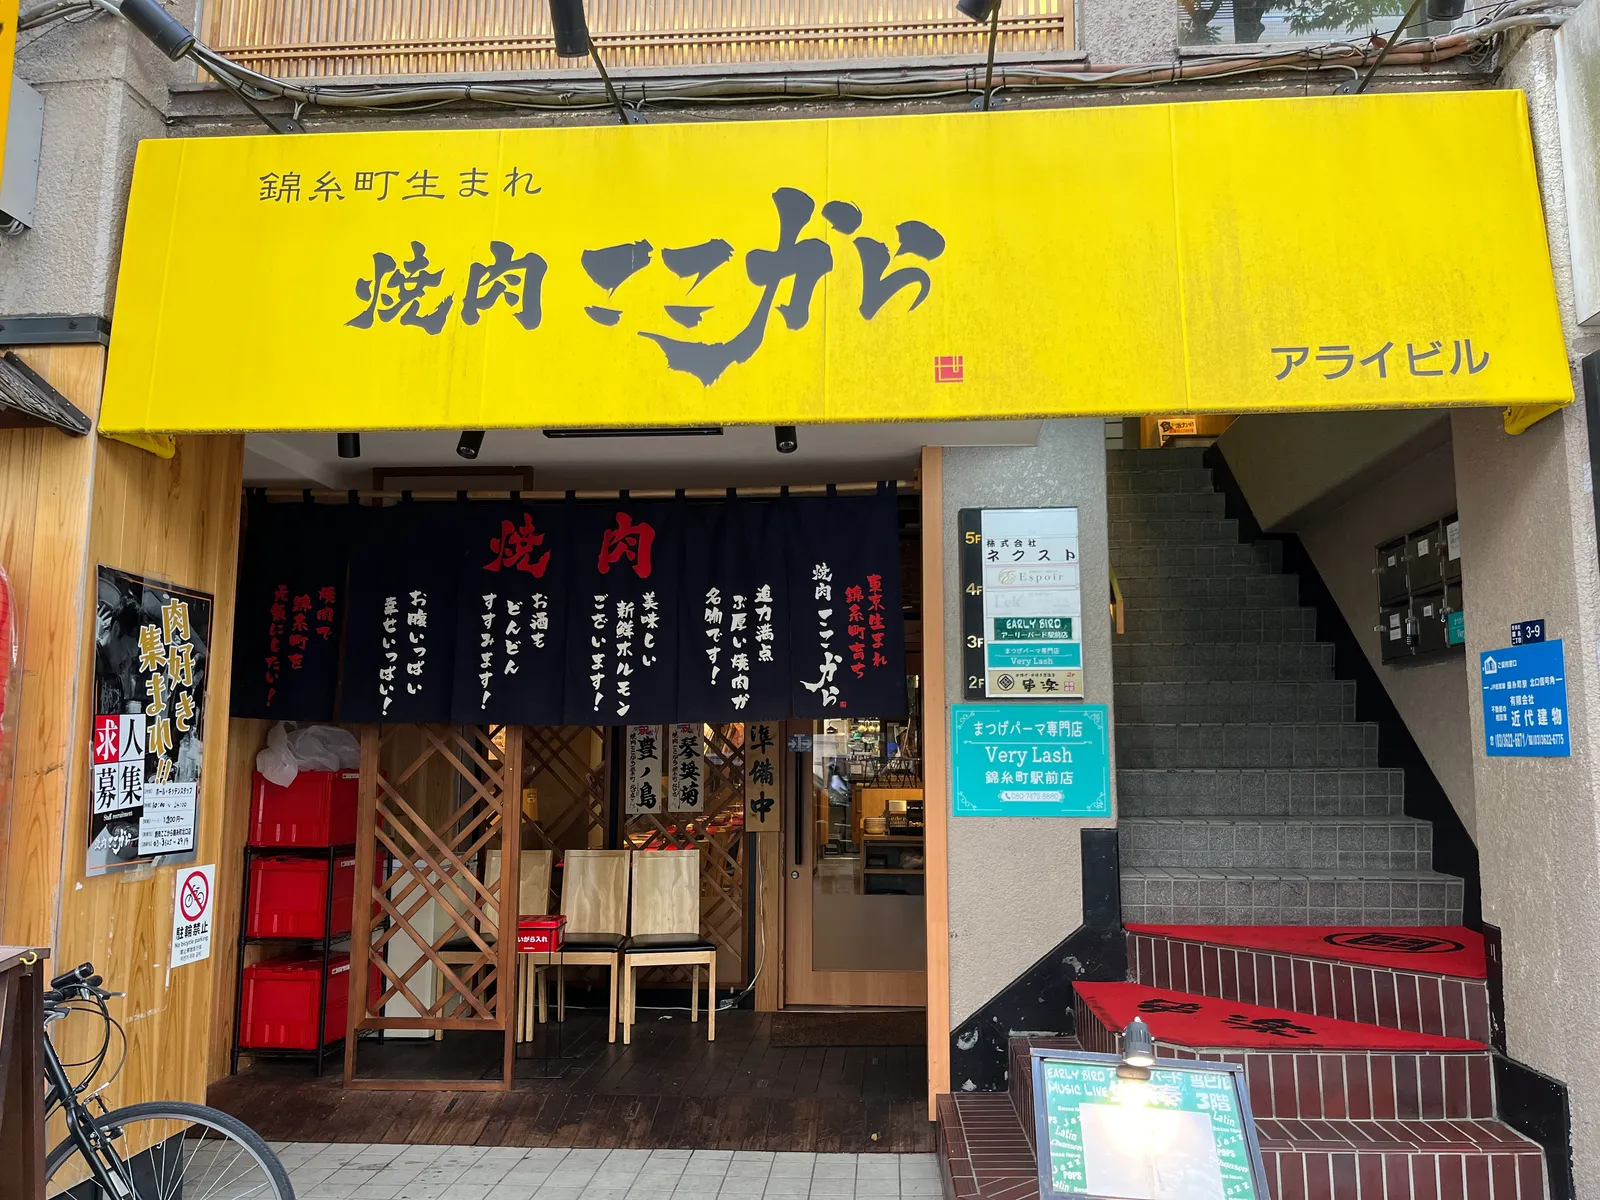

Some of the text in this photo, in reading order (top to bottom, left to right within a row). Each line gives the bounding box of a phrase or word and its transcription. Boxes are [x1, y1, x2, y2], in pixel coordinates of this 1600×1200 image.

[259, 165, 542, 204] 錦糸町生まれ
[344, 186, 945, 388] 焼肉 ここから
[1270, 338, 1491, 381] アライビル
[483, 512, 656, 579] 焼肉
[965, 531, 982, 545] 5F
[986, 539, 1037, 548] 株式会社
[986, 548, 1076, 563] ネクスト
[811, 562, 833, 601] 焼肉
[1018, 571, 1065, 584] Espoir
[965, 583, 983, 596] 4F
[529, 592, 549, 649] お酒も
[640, 591, 660, 667] 美味しい
[754, 583, 775, 663] 迫力満点
[866, 573, 888, 667] 東京生まれ
[1006, 618, 1061, 629] EARLY BIRD
[503, 600, 524, 676] どんどん
[845, 584, 866, 679] 錦糸町育ち
[1526, 624, 1540, 639] 3-9
[406, 589, 428, 695] お腹いっぱい
[966, 635, 984, 649] 3F
[616, 600, 635, 717] 新鮮ホルモン
[730, 594, 751, 711] ぶ厚い焼肉が
[1010, 656, 1054, 667] Very Lash
[161, 598, 196, 732] 肉好き
[968, 676, 985, 689] 2F
[1509, 694, 1535, 707] 有限会社
[1511, 707, 1562, 727] 近代建物
[95, 717, 144, 759] 求人
[973, 720, 1083, 738] まつげパーマ専門店
[984, 746, 1073, 768] Very Lash
[636, 736, 659, 809] 豊ノ島
[748, 724, 775, 824] 準備中
[984, 770, 1074, 785] 錦糸町駅前店
[95, 764, 143, 811] 募集
[176, 920, 209, 941] 駐輪禁止
[1047, 1066, 1106, 1082] EARLY BIRD
[1190, 1073, 1232, 1091] 当ビル
[1047, 1081, 1082, 1096] MUSIC
[1196, 1092, 1231, 1112] 3階
[1213, 1110, 1236, 1128] Latin
[1055, 1125, 1078, 1142] Latin
[1216, 1134, 1244, 1148] Jazz
[1217, 1148, 1236, 1158] POPS
[1052, 1158, 1081, 1174] Jazz
[1063, 1171, 1082, 1181] POPS
